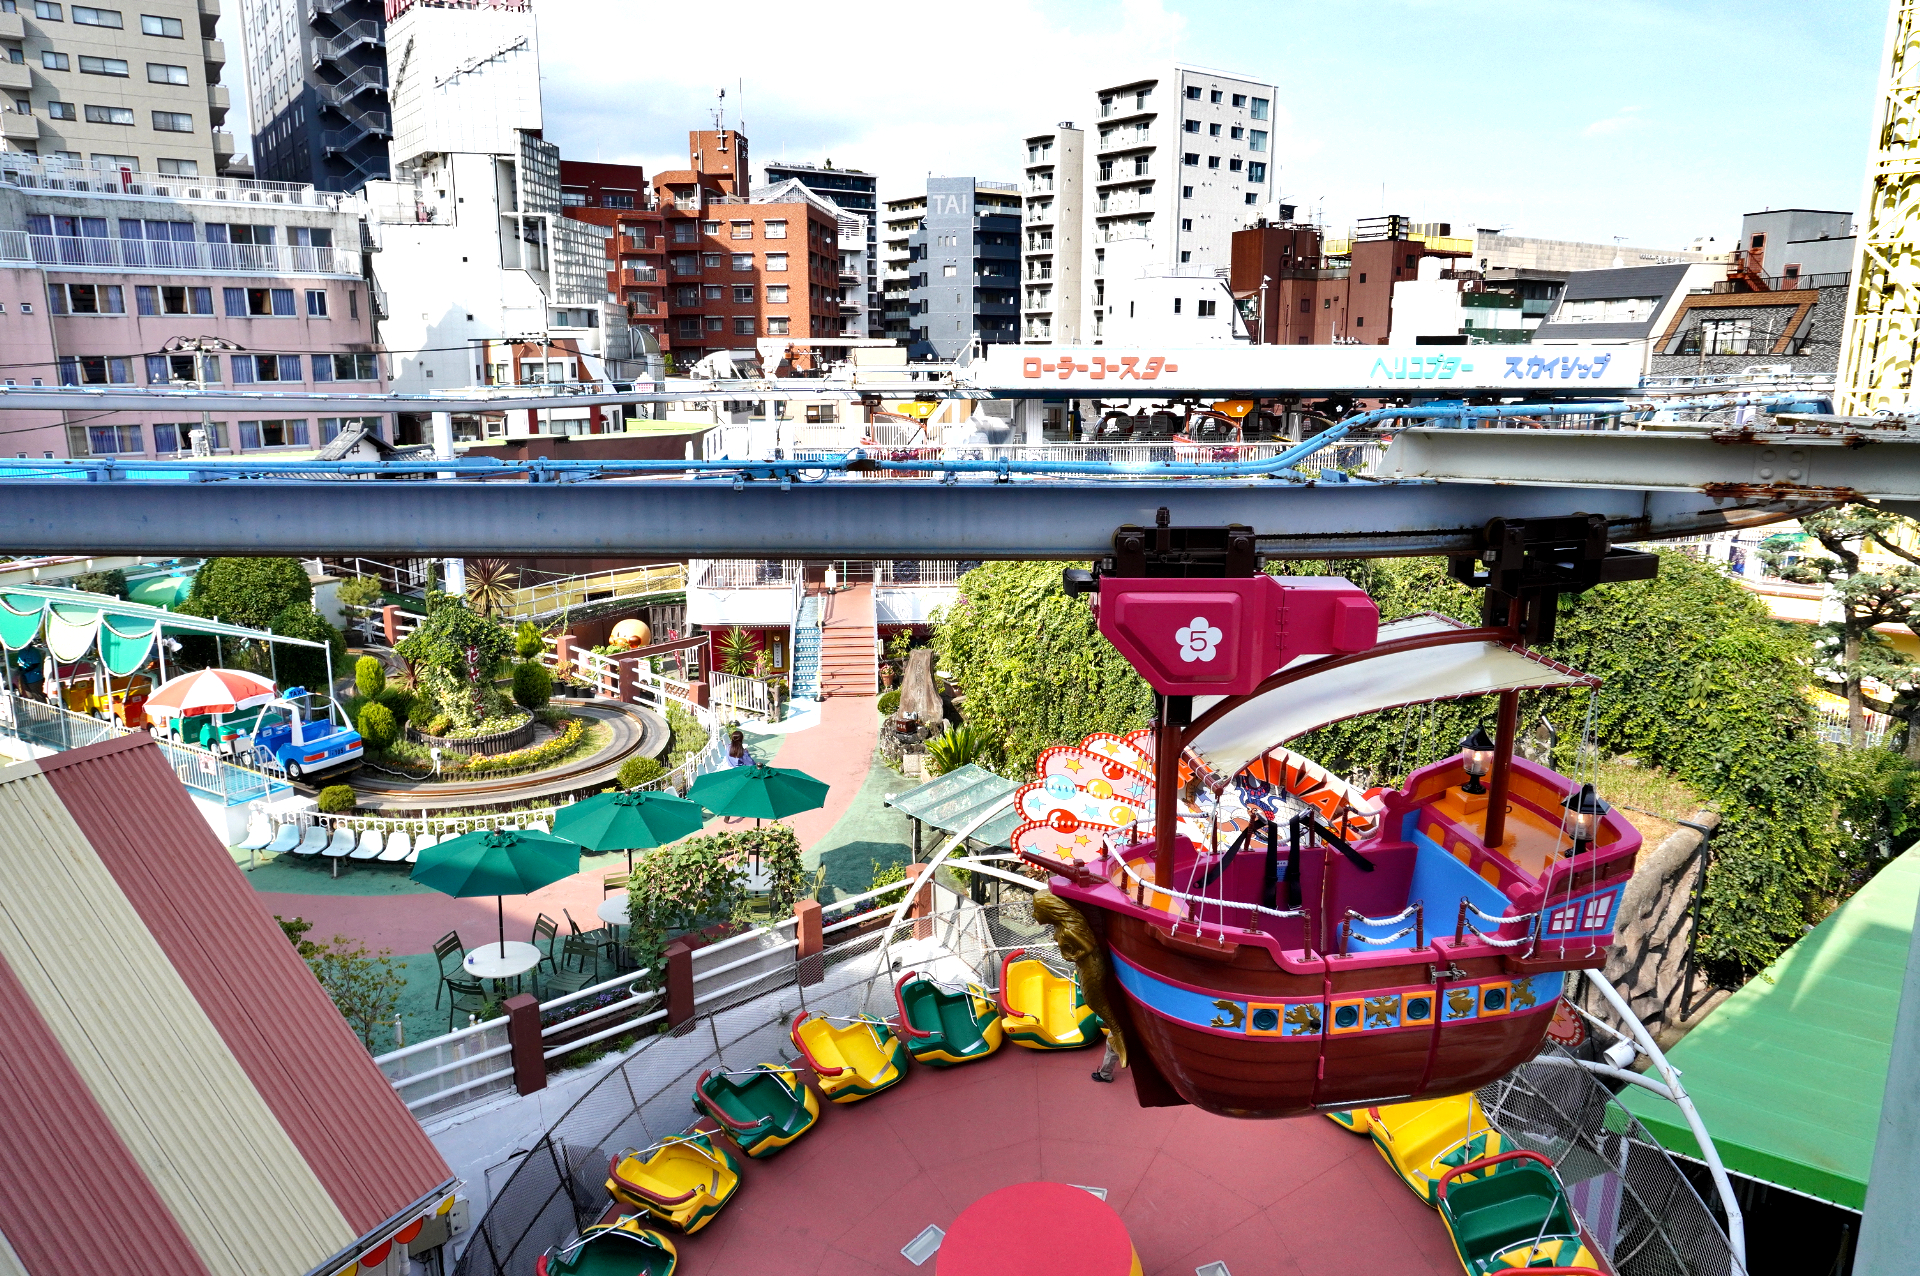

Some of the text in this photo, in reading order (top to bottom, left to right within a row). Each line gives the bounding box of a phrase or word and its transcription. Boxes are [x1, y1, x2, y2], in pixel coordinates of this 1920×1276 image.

[932, 194, 967, 214] TAI
[1023, 356, 1178, 380] ローラーコースター
[1370, 353, 1474, 379] ヘリコプター
[1503, 353, 1611, 379] スカイシップ
[1190, 631, 1207, 652] 5
[289, 688, 304, 698] TAXI
